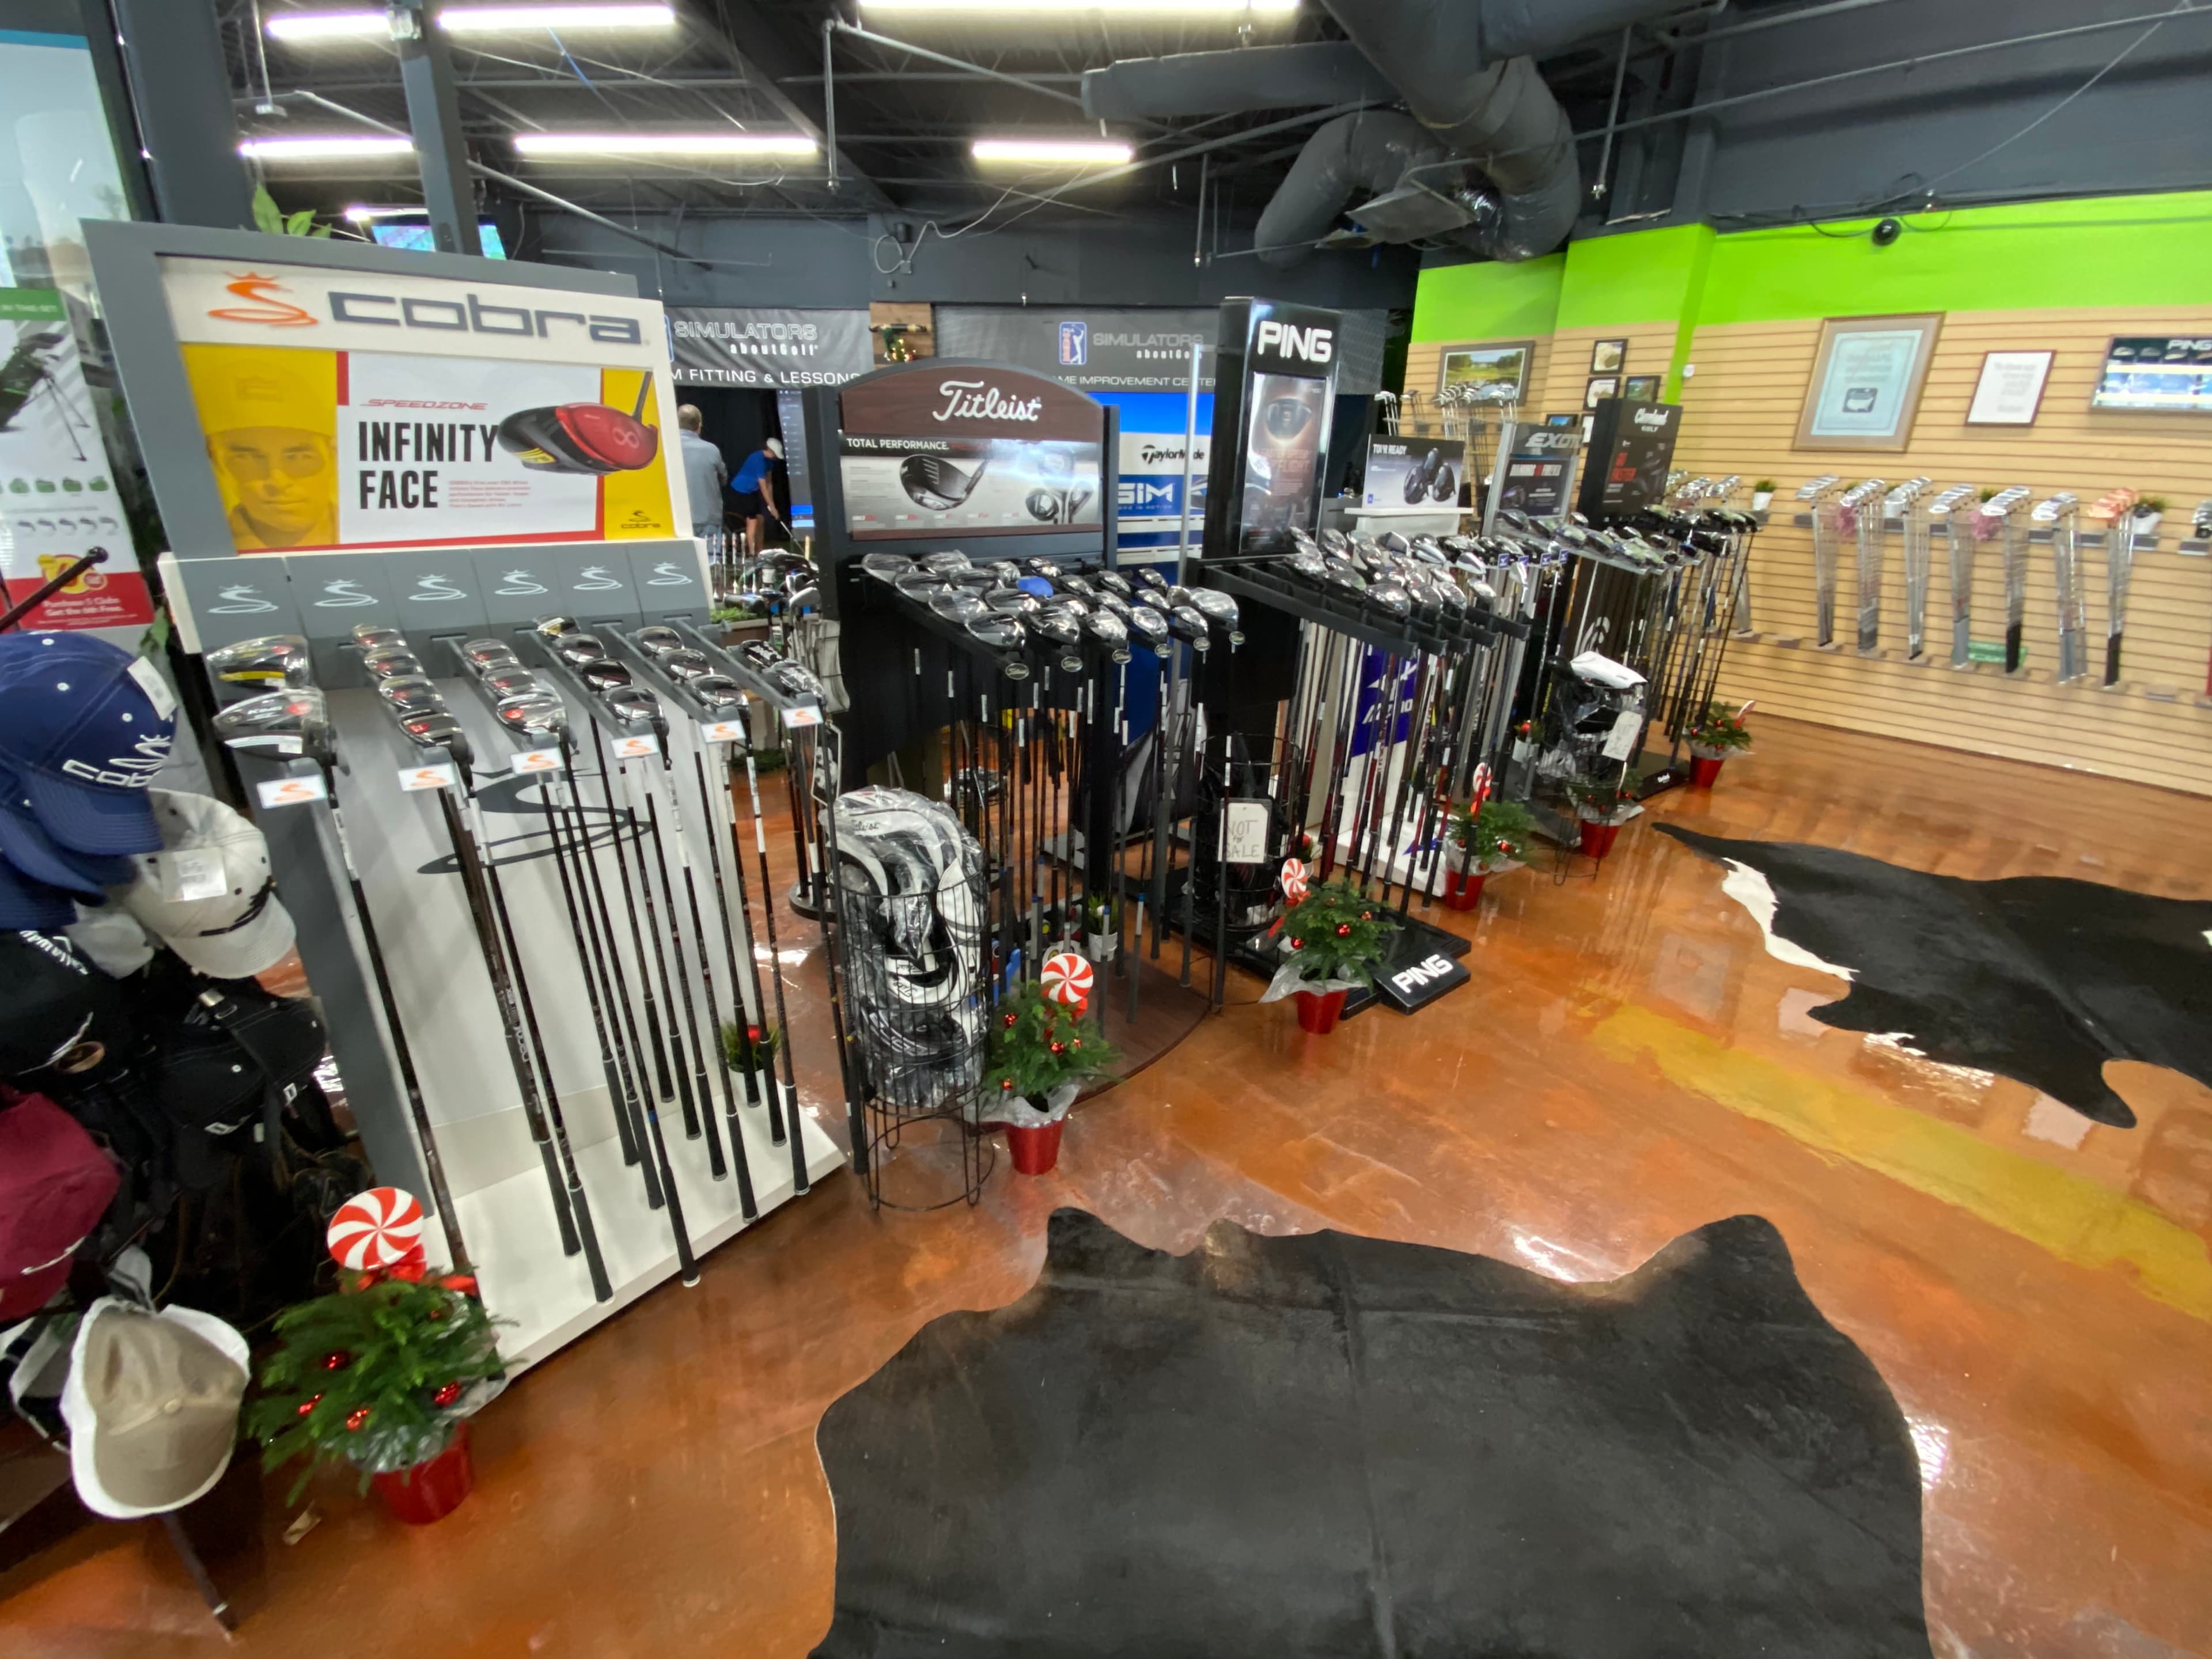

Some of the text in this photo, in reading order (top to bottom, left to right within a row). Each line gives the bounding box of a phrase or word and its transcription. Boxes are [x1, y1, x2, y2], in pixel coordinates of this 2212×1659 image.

[328, 291, 642, 346] cobra
[675, 320, 818, 341] SIMULATORS
[1257, 320, 1333, 363] PING
[690, 369, 756, 382] FITTING
[764, 373, 774, 383] &
[1080, 376, 1170, 387] IMPROVEMENT
[1172, 377, 1215, 387] CETE
[359, 398, 488, 411] SPEEDZONE
[933, 380, 1041, 423] Titleist
[358, 421, 499, 462] INFINITY
[846, 438, 878, 449] TOTAL
[880, 439, 949, 451] PERFORMANCE.
[1142, 445, 1205, 464] TaylorMde
[359, 469, 438, 510] FACE
[1392, 953, 1453, 993] PING
